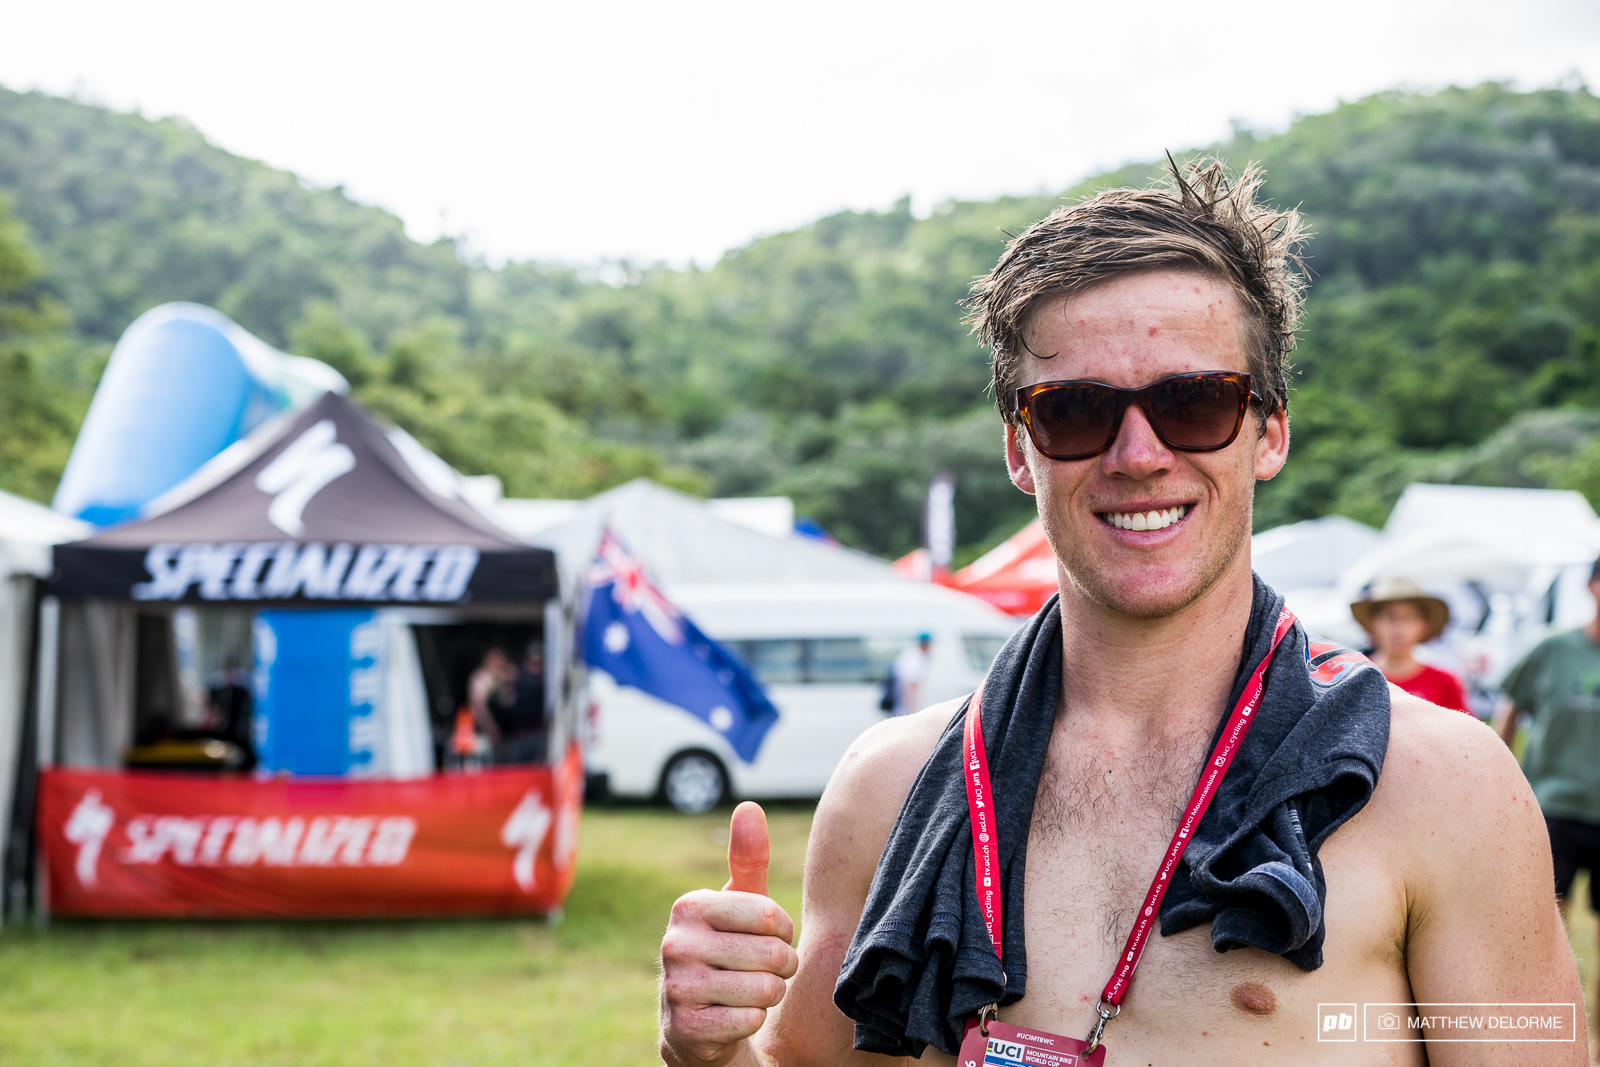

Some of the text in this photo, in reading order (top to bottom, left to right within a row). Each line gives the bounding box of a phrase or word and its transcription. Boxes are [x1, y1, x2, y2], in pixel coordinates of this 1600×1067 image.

[131, 541, 480, 600] SPECIALIZED
[1222, 718, 1247, 757] uci_cycling
[973, 772, 984, 800] UCI_MTB
[1185, 769, 1219, 830] UCI Mountainbike
[978, 812, 986, 832] uci.ch
[120, 816, 417, 866] SPECIALIZED
[982, 845, 990, 875] tv.uci.ch
[1164, 841, 1182, 872] UCI_MTB
[1150, 884, 1162, 907] uci.ch
[1131, 919, 1147, 951] tv.uci.ch
[993, 1042, 1022, 1059] UCI
[1016, 1032, 1054, 1046] #UCIMTBWC
[1025, 1055, 1047, 1065] WORLD
[1047, 1059, 1060, 1067] CUP
[1026, 1049, 1073, 1065] MOUNTAIN BIKE
